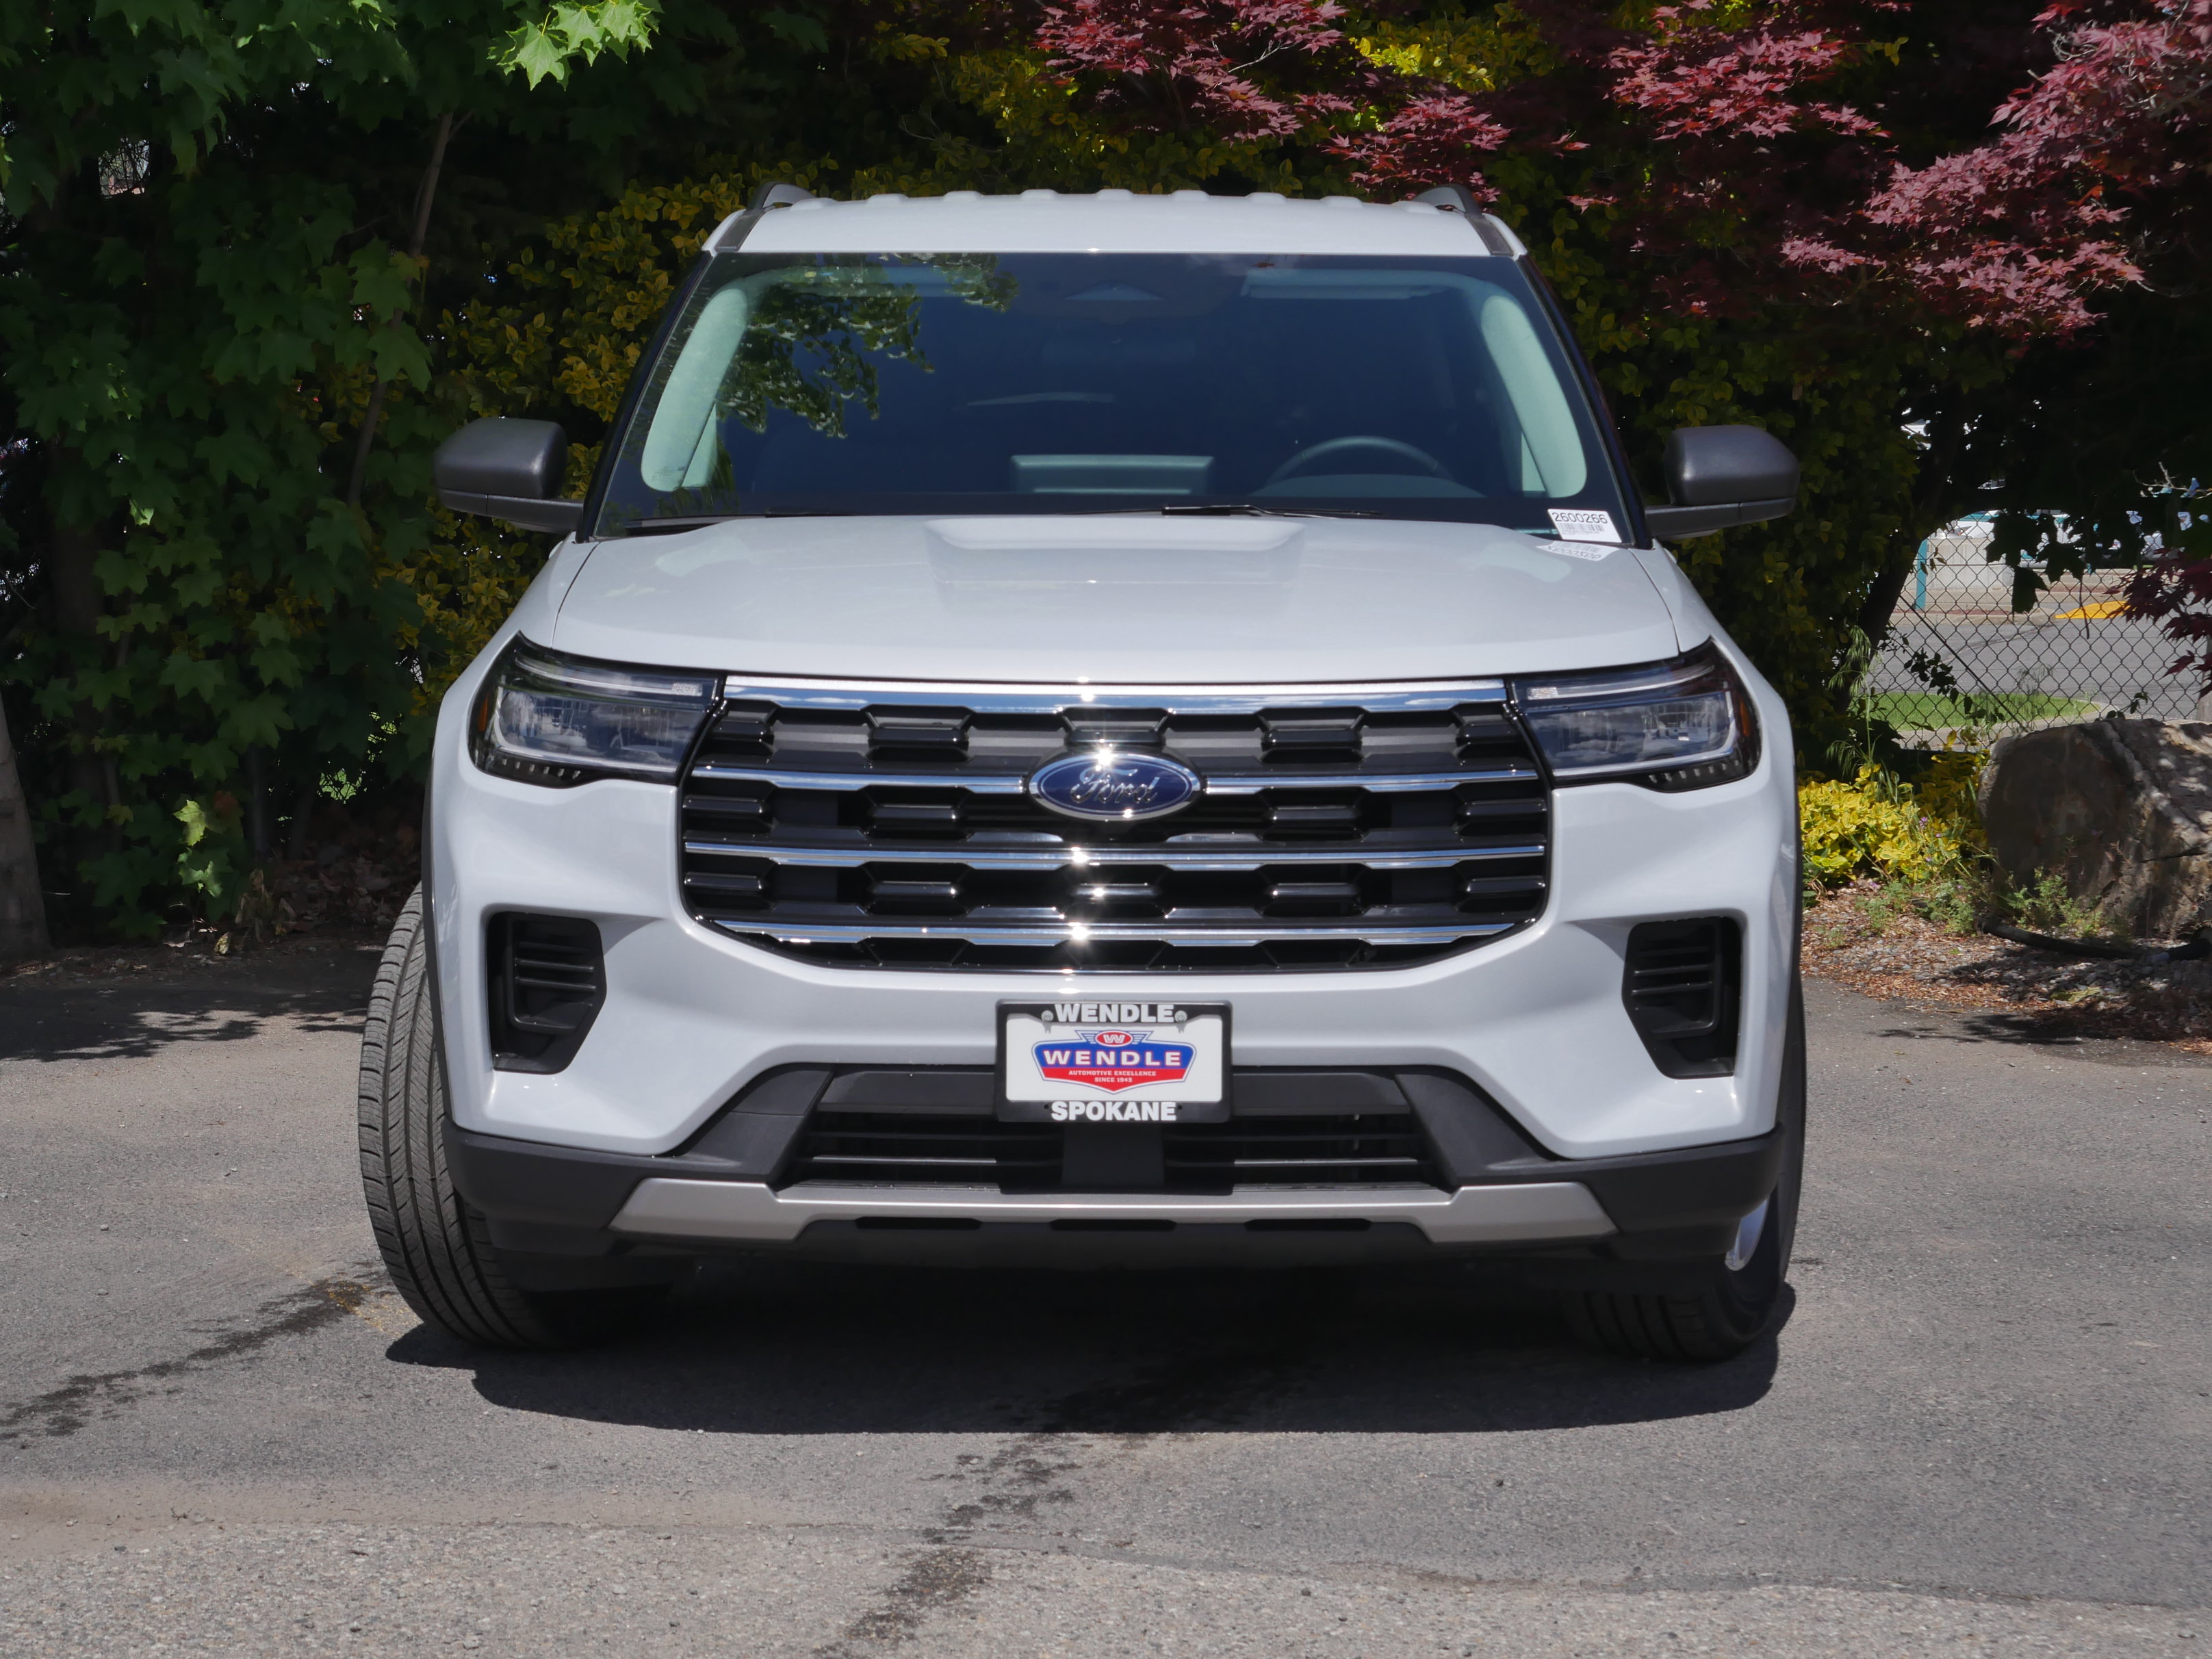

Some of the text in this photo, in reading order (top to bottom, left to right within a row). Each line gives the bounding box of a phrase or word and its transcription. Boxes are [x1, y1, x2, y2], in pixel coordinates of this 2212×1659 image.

[1552, 512, 1608, 524] 2600266
[1070, 767, 1160, 803] Ford
[1054, 1003, 1175, 1023] WENDLE
[1103, 1034, 1126, 1044] W
[1043, 1050, 1181, 1066] WENDLE
[1051, 1101, 1177, 1121] SPOKANE
